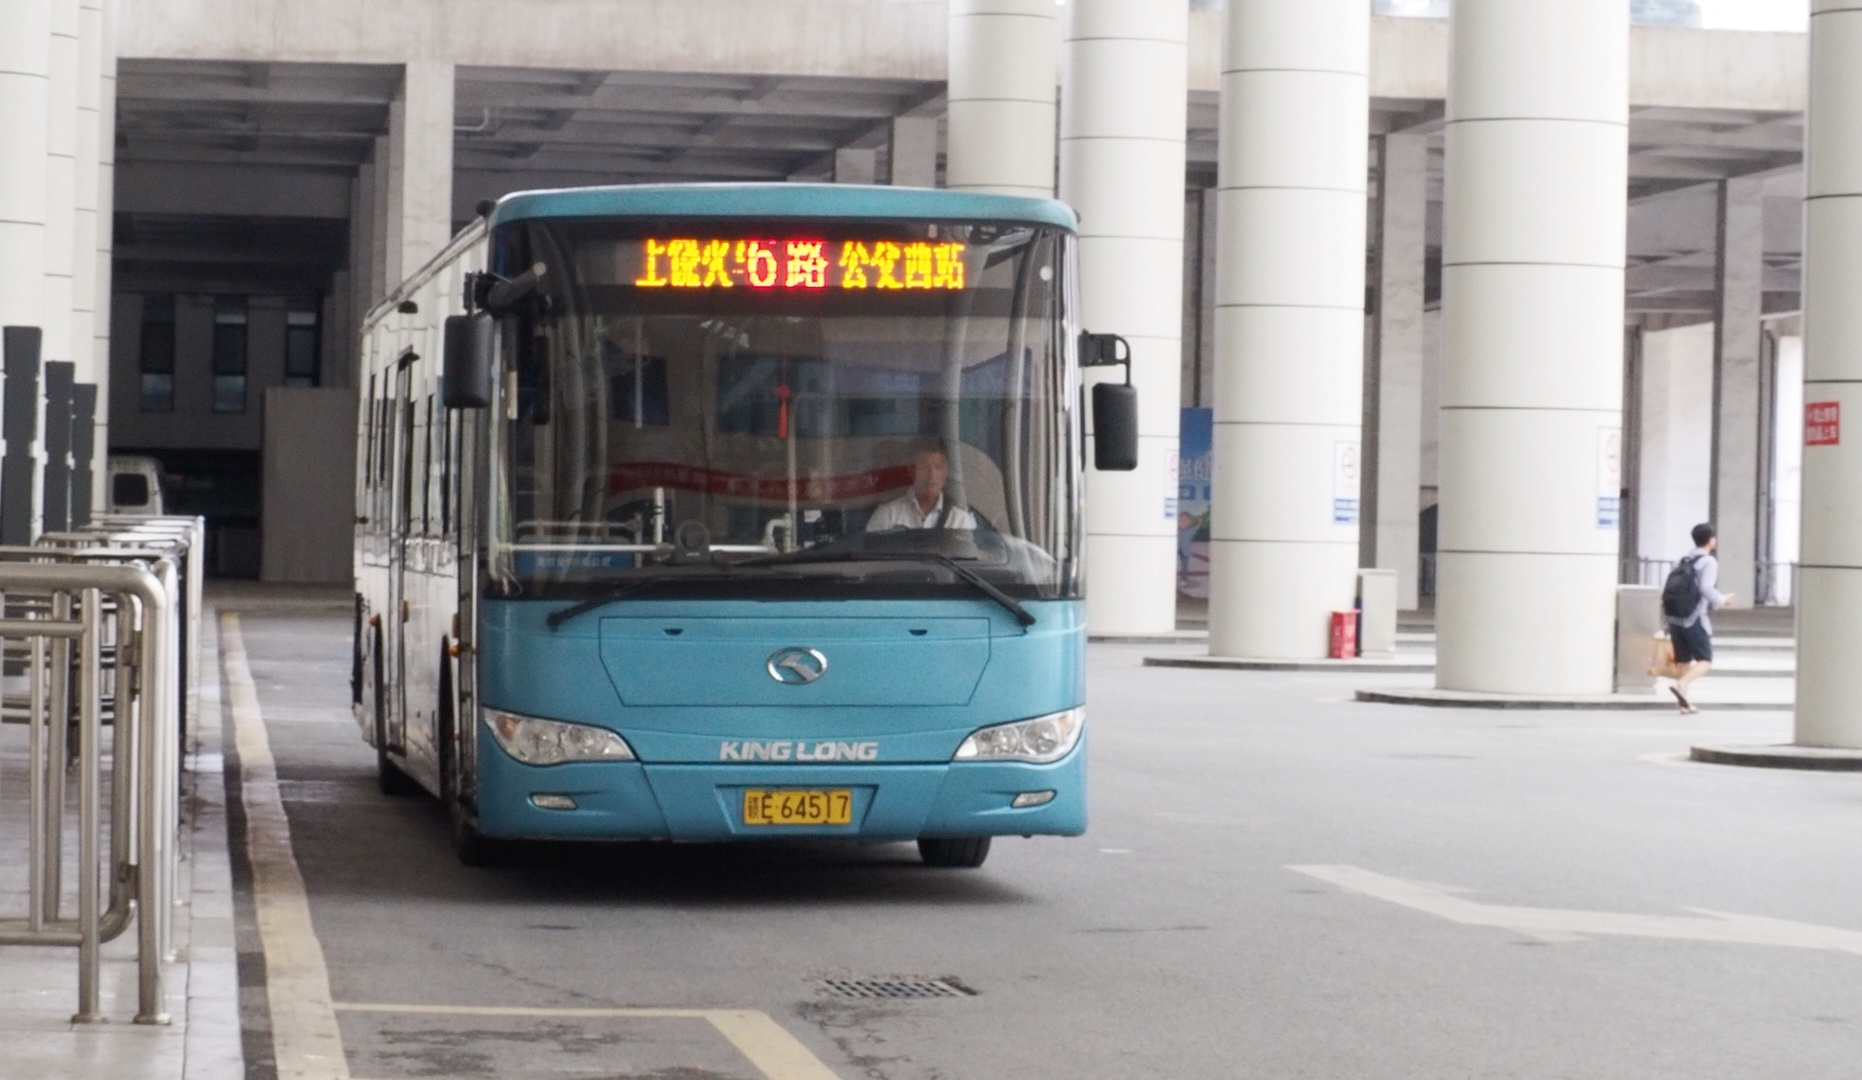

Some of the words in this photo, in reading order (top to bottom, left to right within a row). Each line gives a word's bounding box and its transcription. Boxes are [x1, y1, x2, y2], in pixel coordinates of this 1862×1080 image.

[838, 240, 966, 289] 公交西站
[719, 741, 792, 761] KING
[796, 741, 879, 761] LONG
